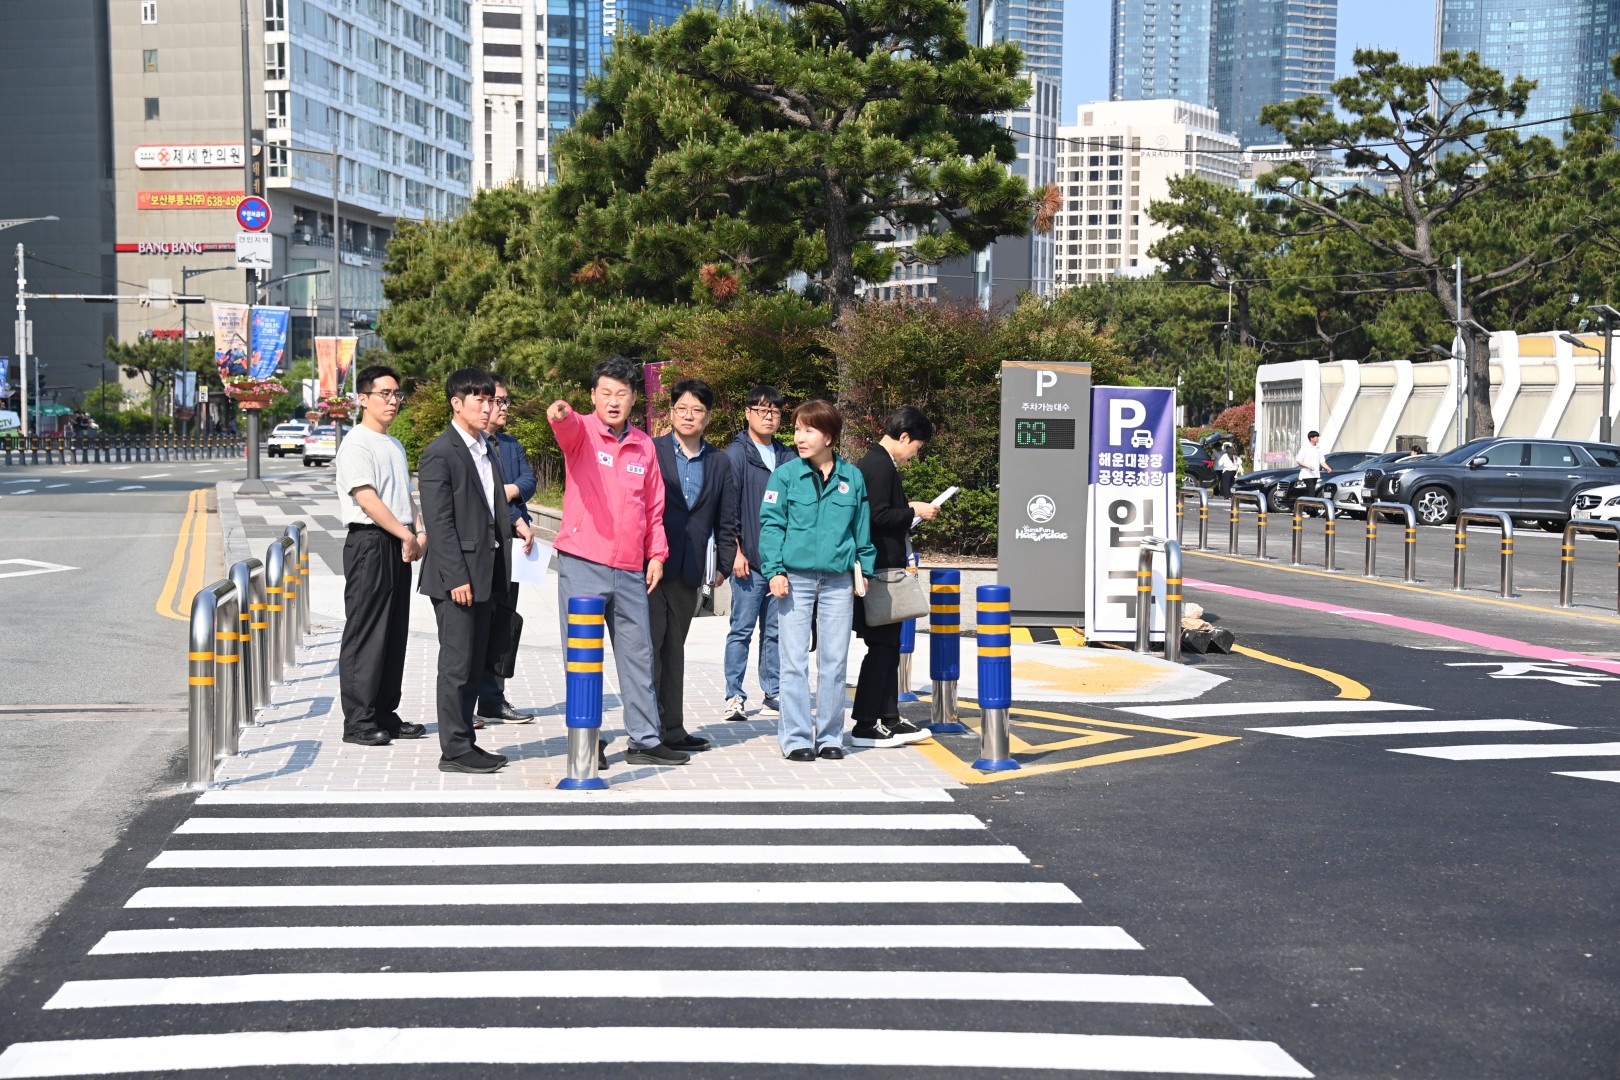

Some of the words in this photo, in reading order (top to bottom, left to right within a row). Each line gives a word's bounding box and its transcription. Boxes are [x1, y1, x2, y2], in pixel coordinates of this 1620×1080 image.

[173, 147, 240, 164] 제세한의원
[1141, 150, 1184, 158] PARADISE
[138, 242, 169, 253] BANG
[171, 242, 202, 253] BANG
[1036, 370, 1058, 397] P
[1021, 402, 1070, 412] 주차가능대수
[1109, 398, 1147, 446] P
[1098, 452, 1163, 469] 해운대광장
[1098, 469, 1163, 486] 공영주차장
[1107, 499, 1156, 619] 입구
